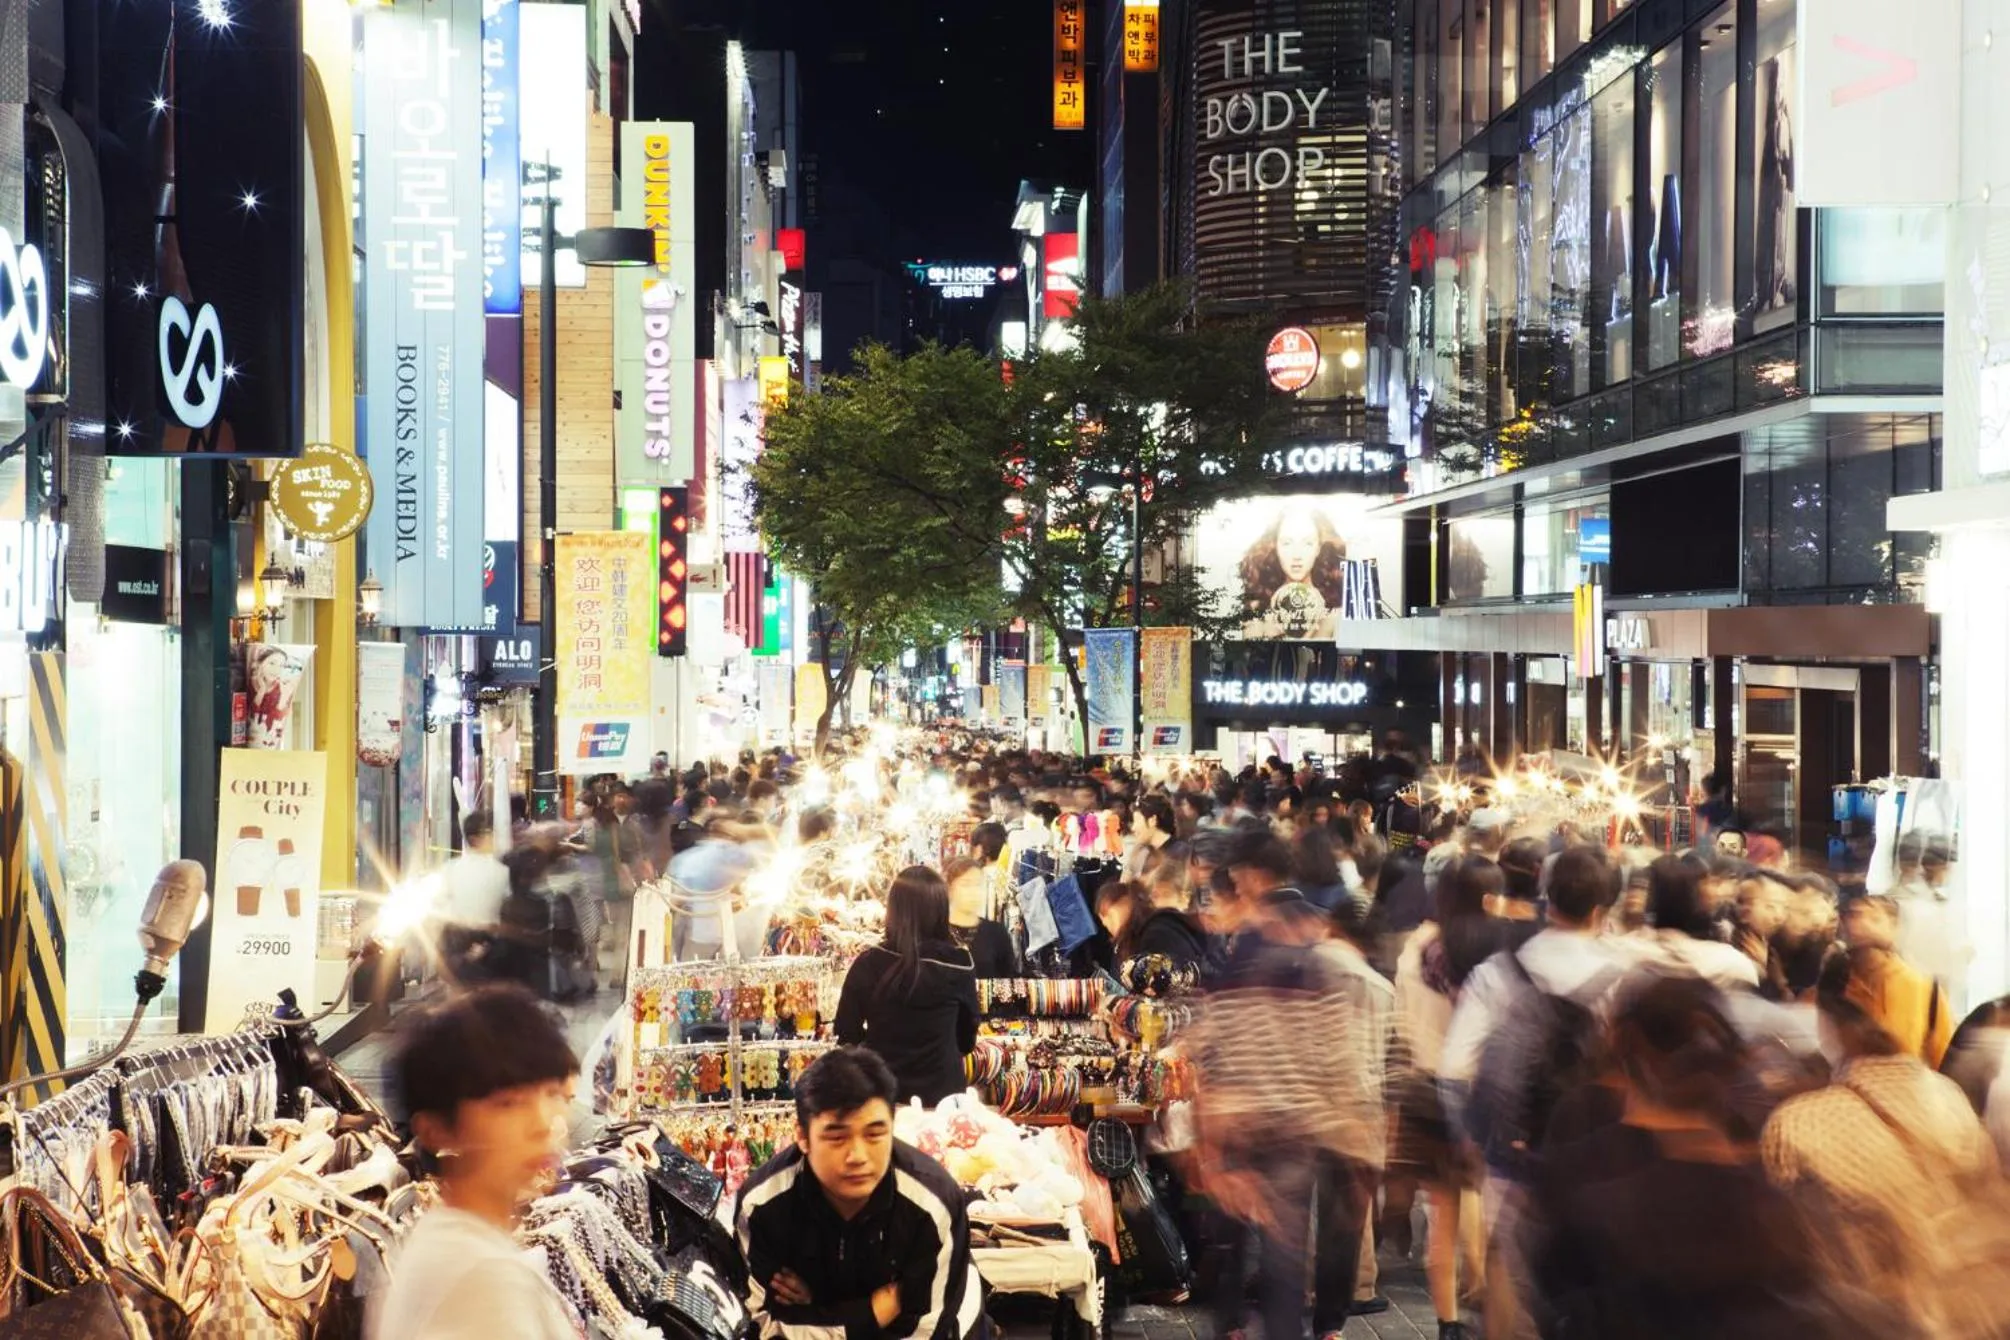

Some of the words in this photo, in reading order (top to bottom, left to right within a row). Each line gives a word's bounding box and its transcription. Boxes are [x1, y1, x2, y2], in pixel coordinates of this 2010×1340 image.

[1127, 14, 1140, 63] 차앤박
[1143, 14, 1156, 61] 피부과
[1216, 31, 1304, 80] THE
[1059, 49, 1079, 108] 피부과
[1206, 87, 1330, 140] BODY
[382, 18, 467, 310] 바오로딸
[1208, 147, 1325, 197] SHOP
[954, 267, 996, 282] HSBC
[396, 344, 418, 441] BOOKS
[644, 314, 671, 461] DONUTS
[292, 464, 332, 485] SKIN
[397, 446, 416, 464] &
[320, 479, 352, 490] FOOD
[396, 473, 418, 563] MEDIA
[494, 640, 533, 660] ALO
[1607, 618, 1644, 649] PLAZA
[1203, 680, 1243, 703] THE
[1247, 680, 1307, 705] BODY
[1309, 681, 1368, 705] SHOP
[231, 779, 314, 797] COUPLE
[263, 799, 301, 821] City
